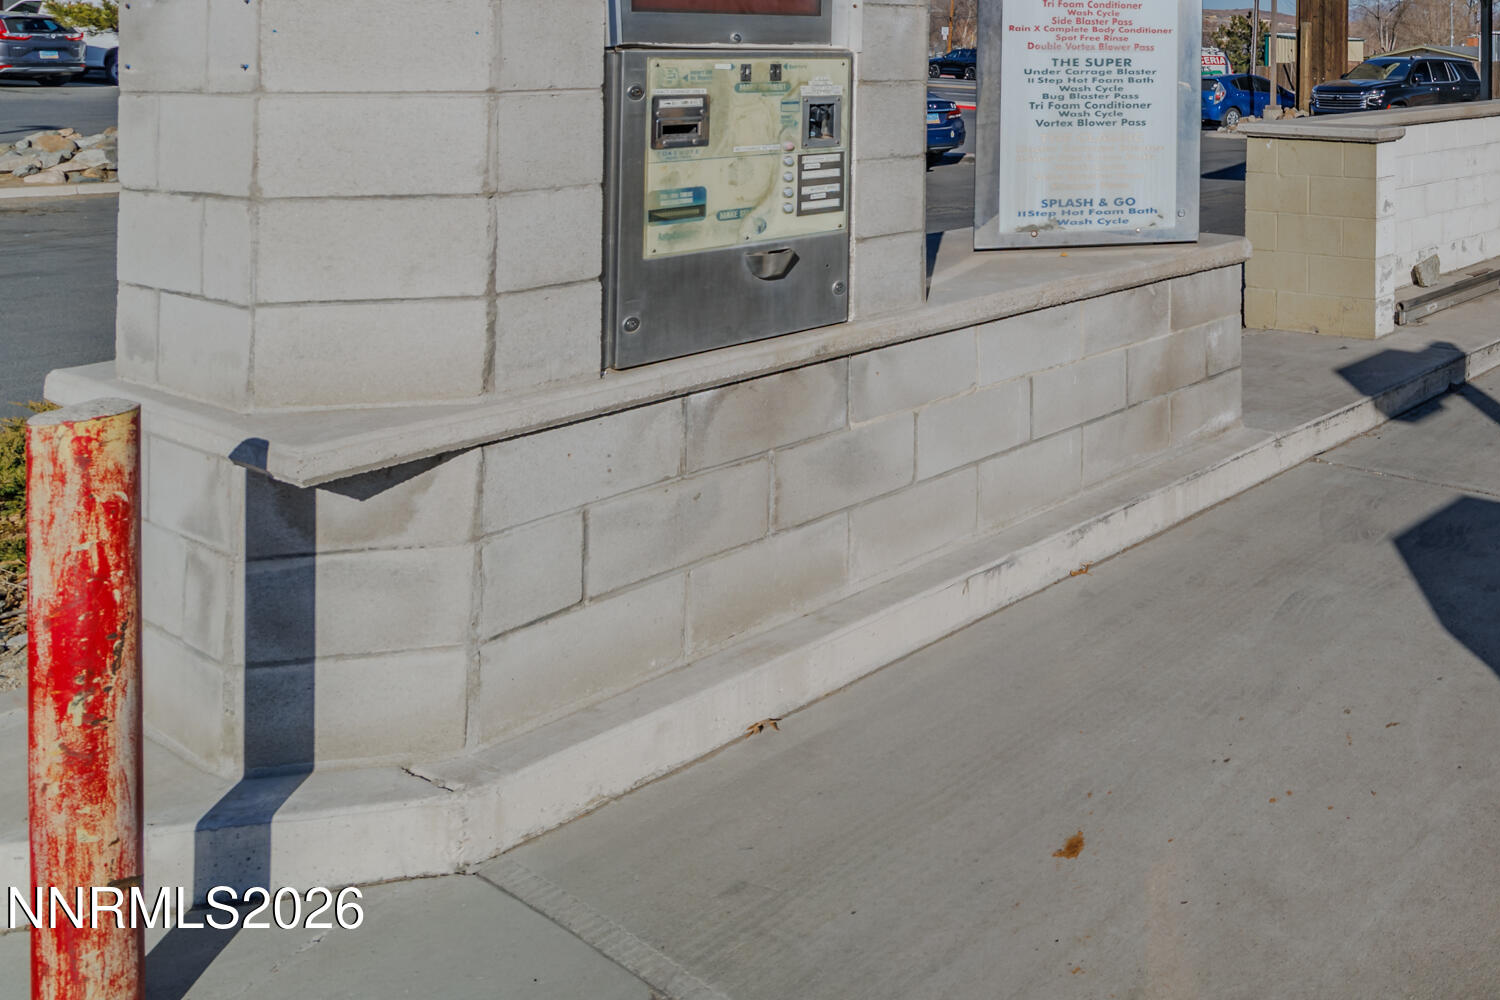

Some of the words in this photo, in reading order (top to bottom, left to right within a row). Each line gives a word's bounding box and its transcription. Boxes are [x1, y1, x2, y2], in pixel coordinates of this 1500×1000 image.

[1058, 0, 1084, 8] Foam
[1087, 0, 1143, 9] Conditioner
[1096, 10, 1120, 18] Cycle
[1051, 17, 1072, 25] Side
[1076, 17, 1108, 25] Blaster
[1112, 18, 1133, 26] Pass
[1043, 26, 1089, 34] Complete
[1027, 42, 1062, 50] Double
[1098, 43, 1131, 51] Blower
[1134, 43, 1155, 51] Pass
[1051, 58, 1079, 67] THE
[1085, 58, 1132, 67] SUPER
[1065, 68, 1113, 76] Carrage
[1037, 77, 1063, 85] Step
[1095, 85, 1124, 93] Cycle
[1042, 93, 1065, 101] Bug
[1029, 101, 1043, 110] Tri
[1048, 102, 1080, 110] Foam
[1084, 101, 1152, 109] Conditioner
[1035, 119, 1073, 127] Vortex
[1077, 119, 1117, 127] Blower
[1121, 119, 1147, 127] Pass
[1041, 199, 1093, 208] SPLASH
[1099, 198, 1108, 207] &
[1113, 197, 1136, 207] GO
[1028, 210, 1057, 218] Step
[1097, 218, 1129, 226] Cycle
